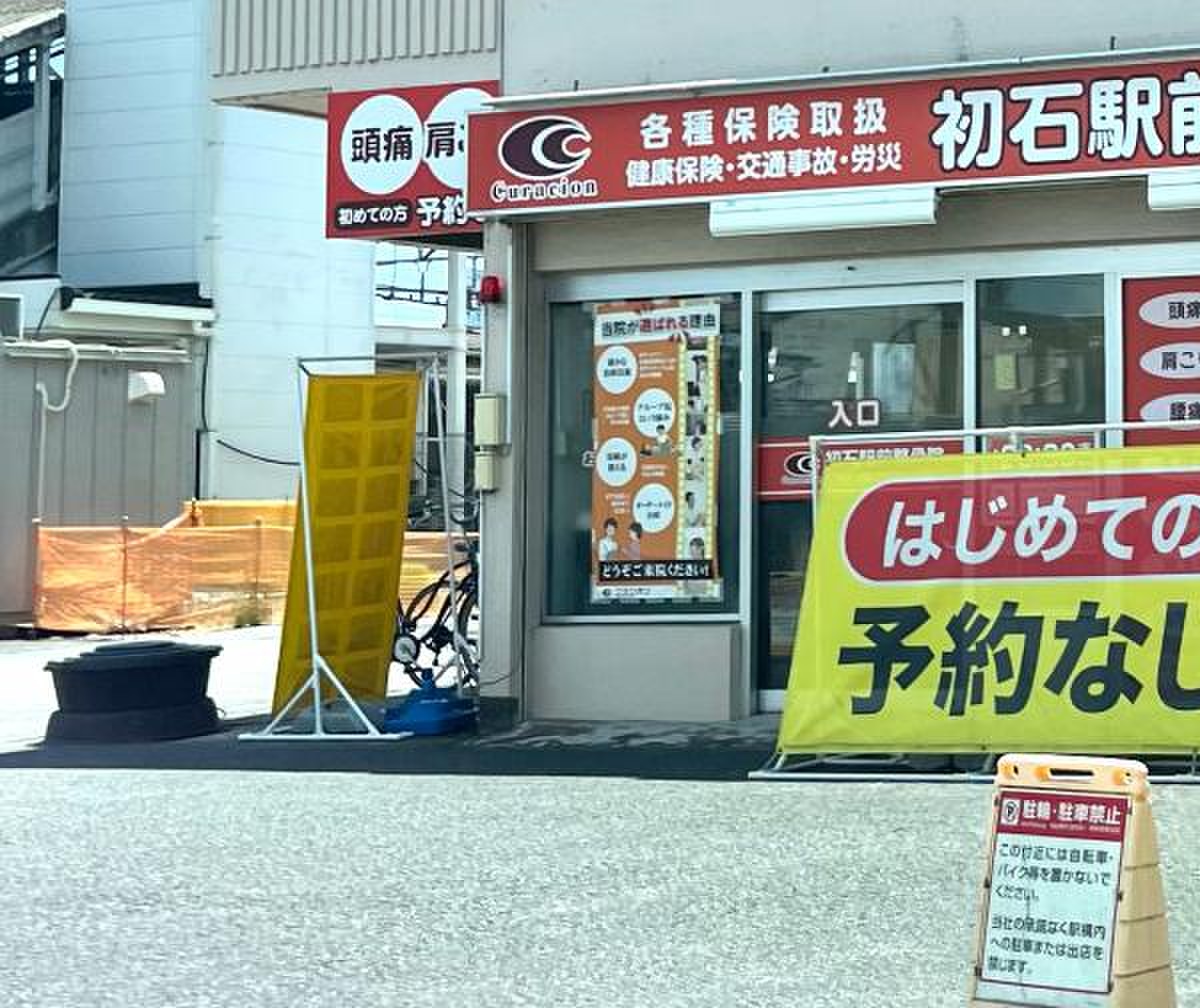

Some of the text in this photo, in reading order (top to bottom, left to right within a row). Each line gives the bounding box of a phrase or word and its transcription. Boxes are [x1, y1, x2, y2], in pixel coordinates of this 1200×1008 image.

[425, 121, 464, 159] 肩
[639, 97, 888, 150] 各種保険取扱
[351, 124, 414, 164] 頭痛
[624, 141, 903, 189] 健康保険・交通事故・労災
[491, 177, 599, 204] Curacion
[337, 204, 409, 225] 初めての方
[828, 399, 880, 428] 入口
